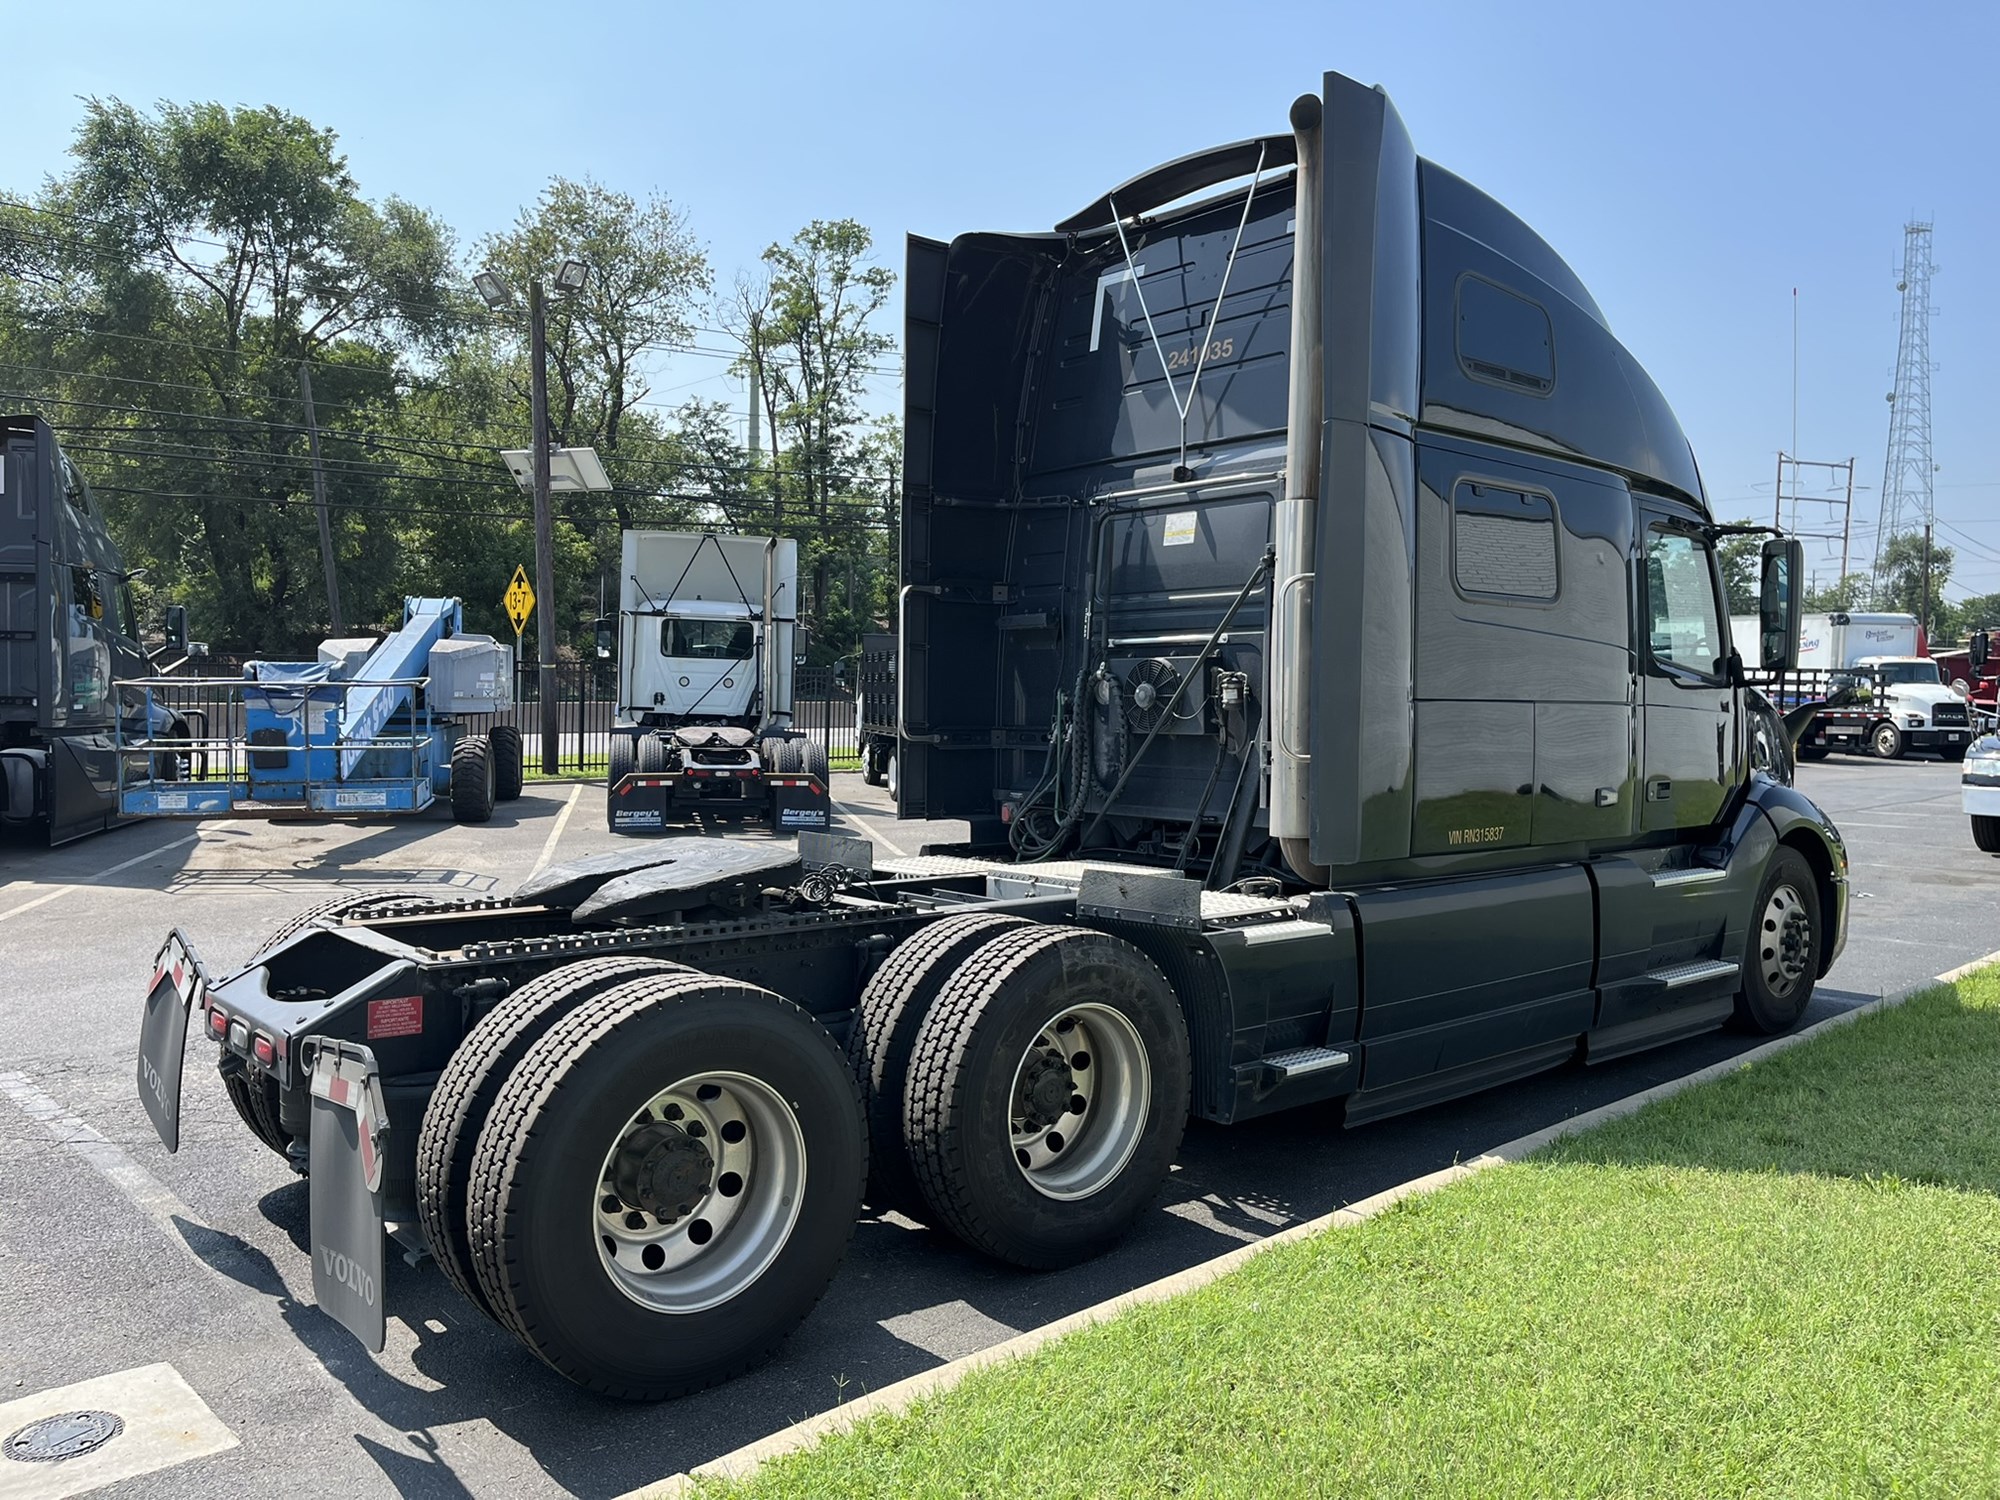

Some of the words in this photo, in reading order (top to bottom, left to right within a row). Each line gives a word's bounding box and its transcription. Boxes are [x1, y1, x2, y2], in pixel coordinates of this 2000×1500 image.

[1168, 338, 1233, 370] 241035
[615, 809, 660, 817] Bergey's
[782, 808, 825, 816] Bergey's
[1448, 829, 1462, 845] VIN
[1463, 826, 1504, 844] RN315837
[142, 1054, 172, 1121] VOLVO
[319, 1244, 375, 1307] VOLVO
